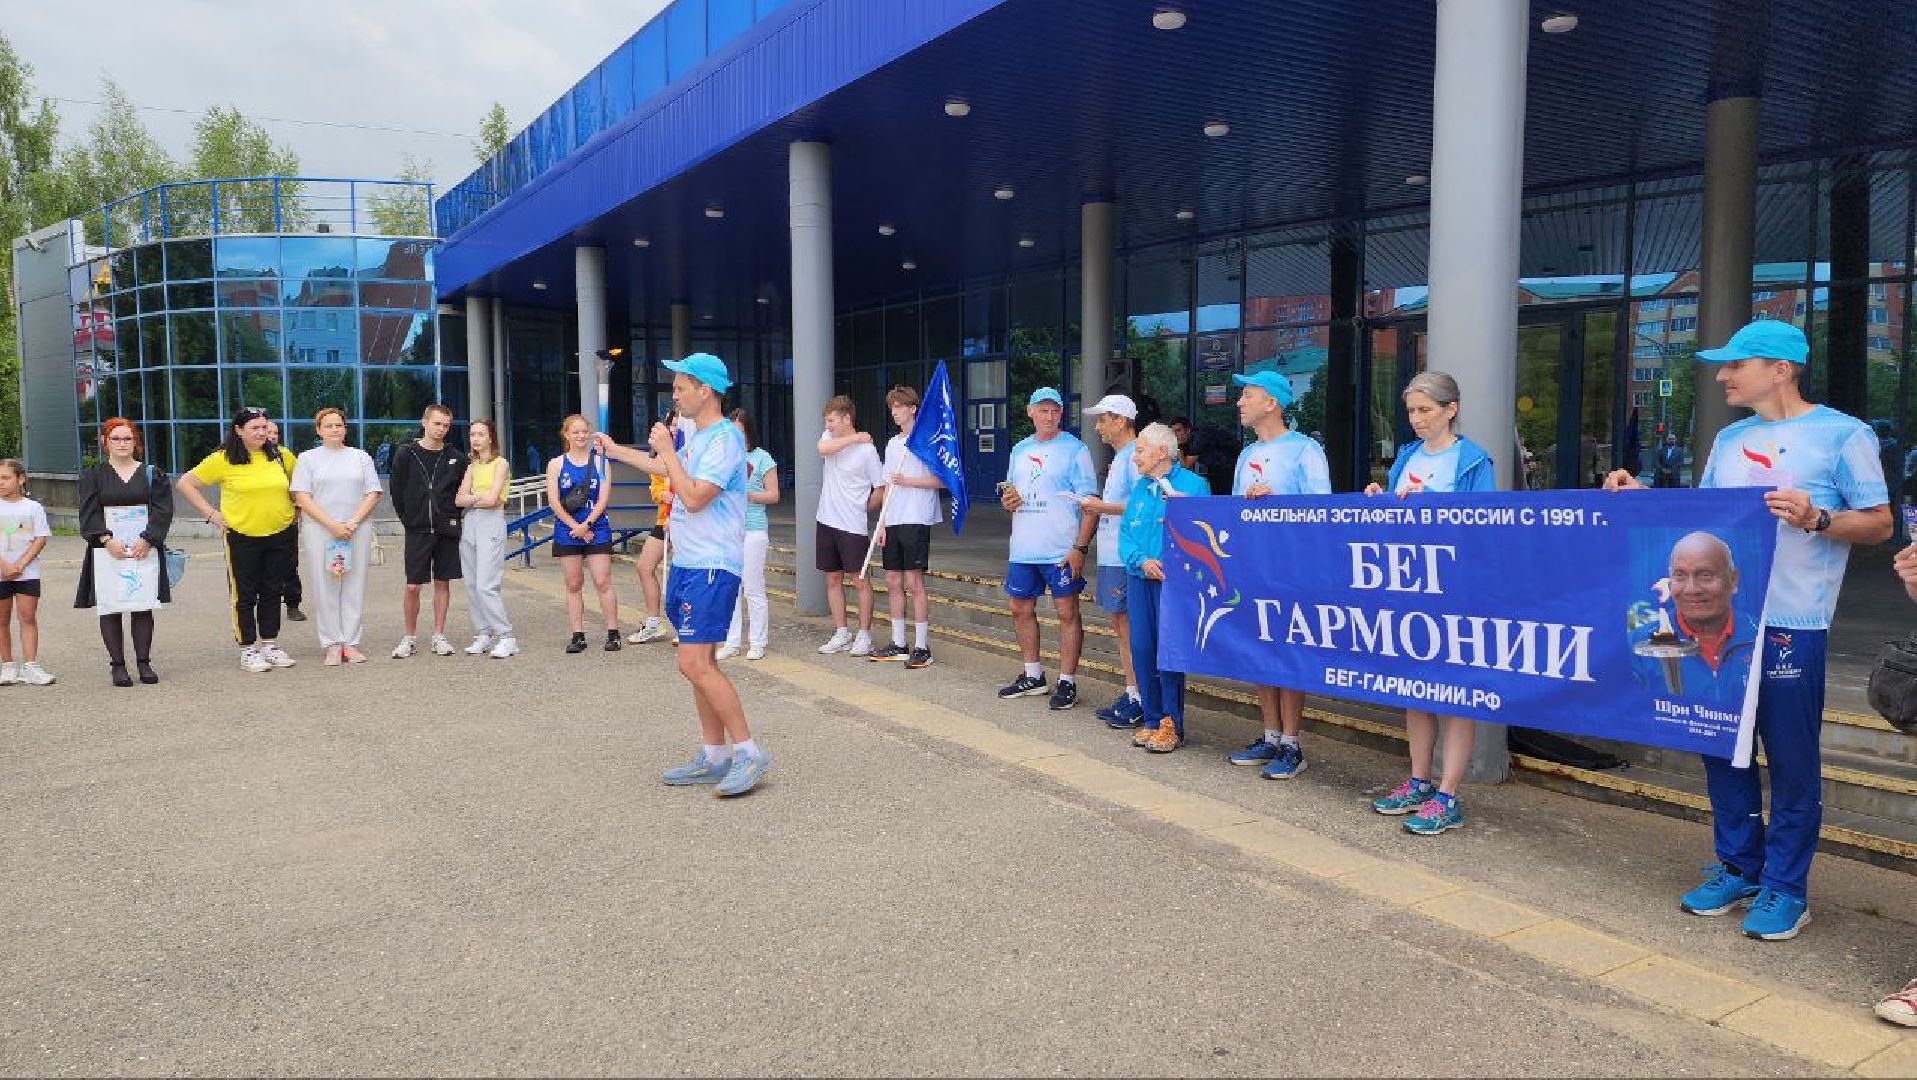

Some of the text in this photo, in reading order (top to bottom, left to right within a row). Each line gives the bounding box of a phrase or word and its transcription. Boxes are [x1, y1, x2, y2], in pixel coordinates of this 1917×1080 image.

[1240, 507, 1609, 526] ФАКЕЛЬНАЯ ЭСТАФЕТА В РОССИИ С 1991 г.
[1347, 541, 1456, 595] БЕГ
[1253, 598, 1596, 682] ГАРМОНИИ
[1325, 667, 1501, 711] БЕГ-ГАРМОНИИ.РФ
